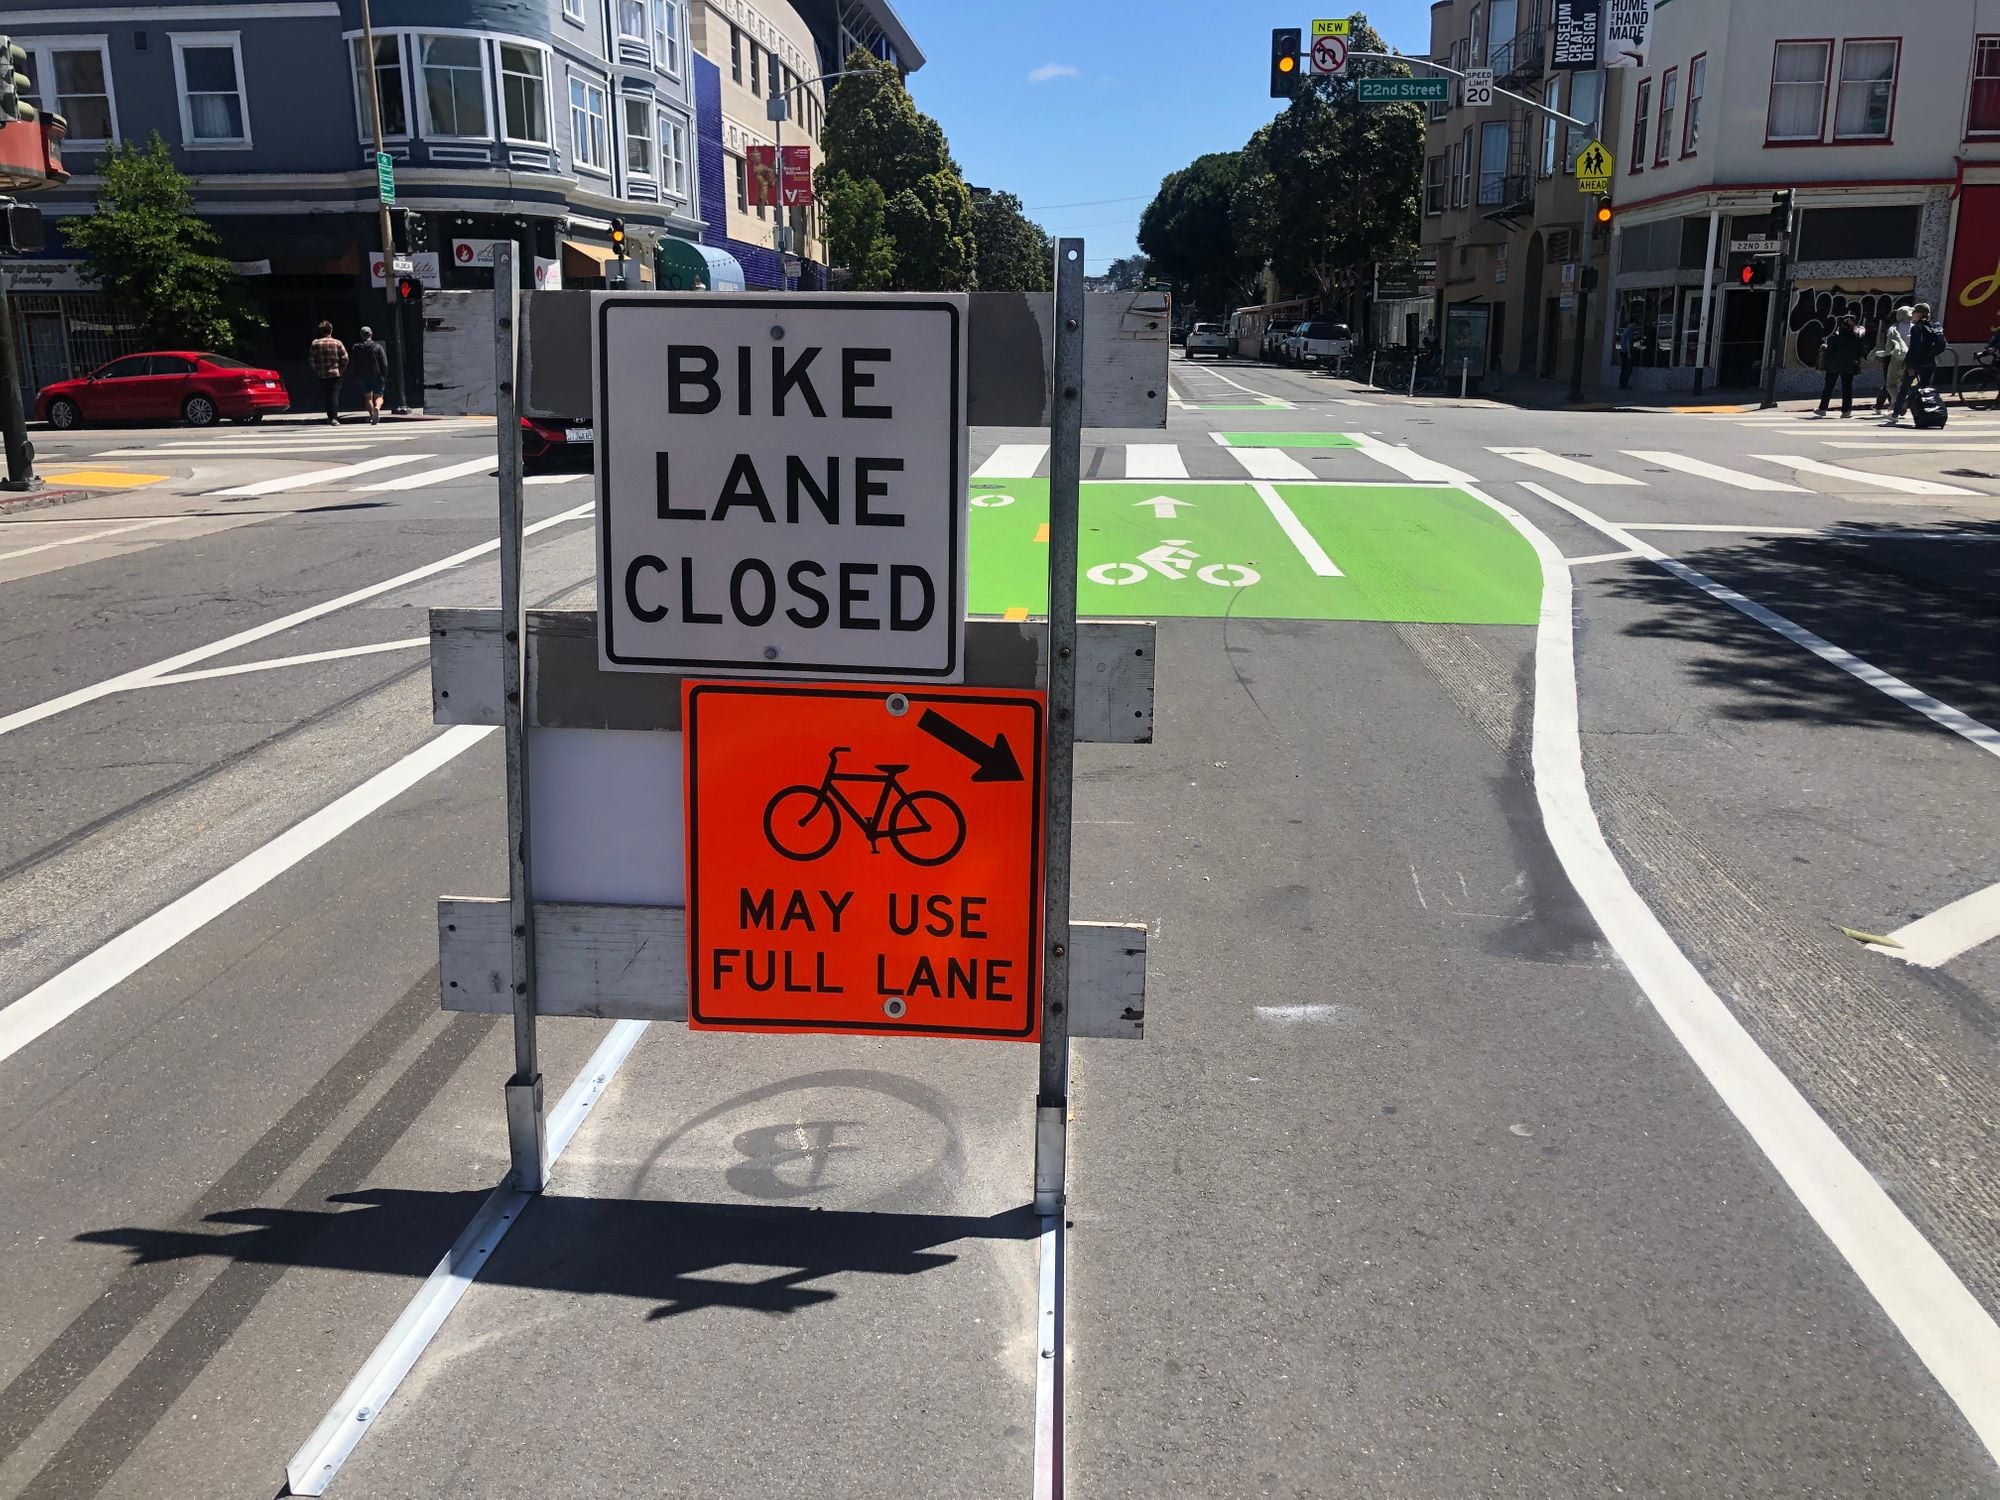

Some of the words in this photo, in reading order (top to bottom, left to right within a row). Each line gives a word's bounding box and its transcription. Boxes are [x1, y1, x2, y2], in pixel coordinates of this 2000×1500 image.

[1611, 0, 1648, 11] HOME
[1615, 11, 1649, 26] HAND
[1318, 23, 1343, 32] NEW
[1555, 3, 1572, 63] MUSEUM
[1609, 25, 1645, 40] MADE
[1568, 19, 1584, 62] CRAFT
[1581, 12, 1597, 61] DESIGN
[1363, 84, 1398, 96] 22nd
[1401, 84, 1443, 96] Street
[1469, 79, 1488, 87] LIMIT
[1466, 88, 1490, 103] 20
[1580, 181, 1607, 190] AHEAD
[1737, 242, 1760, 250] 22ND
[667, 345, 893, 419] BIKE
[656, 451, 905, 527] LANE
[625, 555, 936, 632] CLOSED
[739, 887, 855, 933] MAY
[888, 893, 988, 940] USE
[713, 948, 844, 994] FULL
[877, 953, 1013, 1003] LANE
